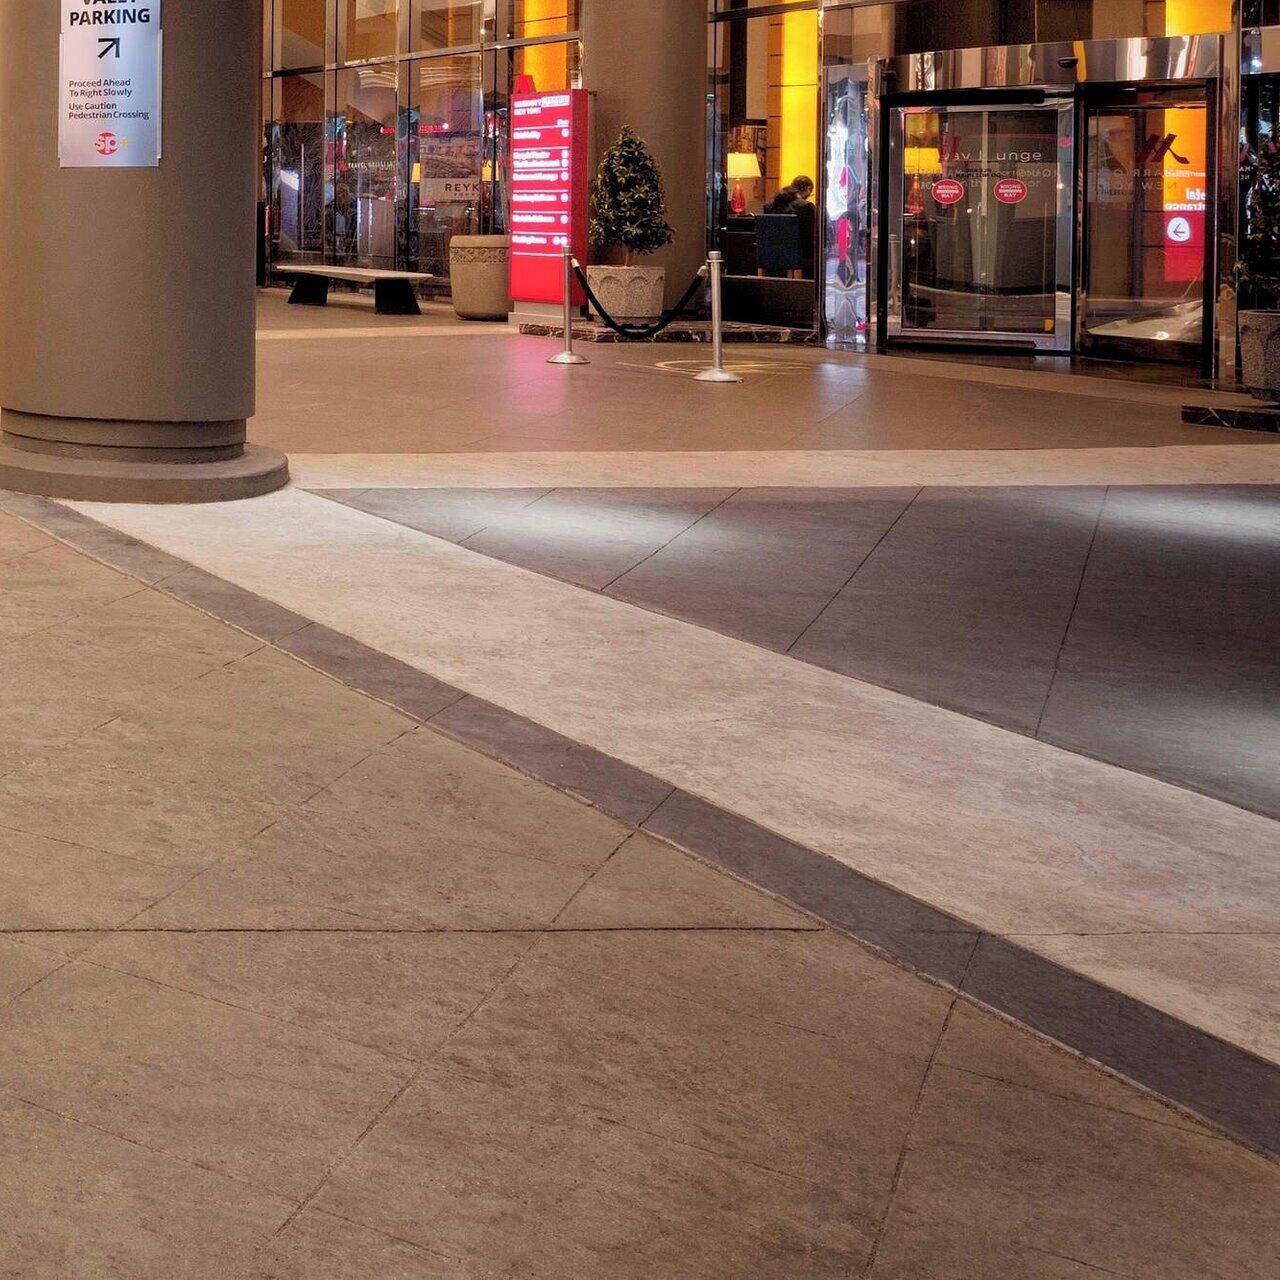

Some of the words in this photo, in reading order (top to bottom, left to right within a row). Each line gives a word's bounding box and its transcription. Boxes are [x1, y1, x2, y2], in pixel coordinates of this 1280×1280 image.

[69, 9, 151, 26] PARKING
[69, 80, 102, 88] Proceed
[80, 88, 102, 99] Right
[104, 88, 132, 98] Slowly
[69, 103, 83, 111] Use
[85, 102, 117, 110] Caution
[69, 111, 113, 120] Pedestrian
[113, 110, 150, 120] Crossing
